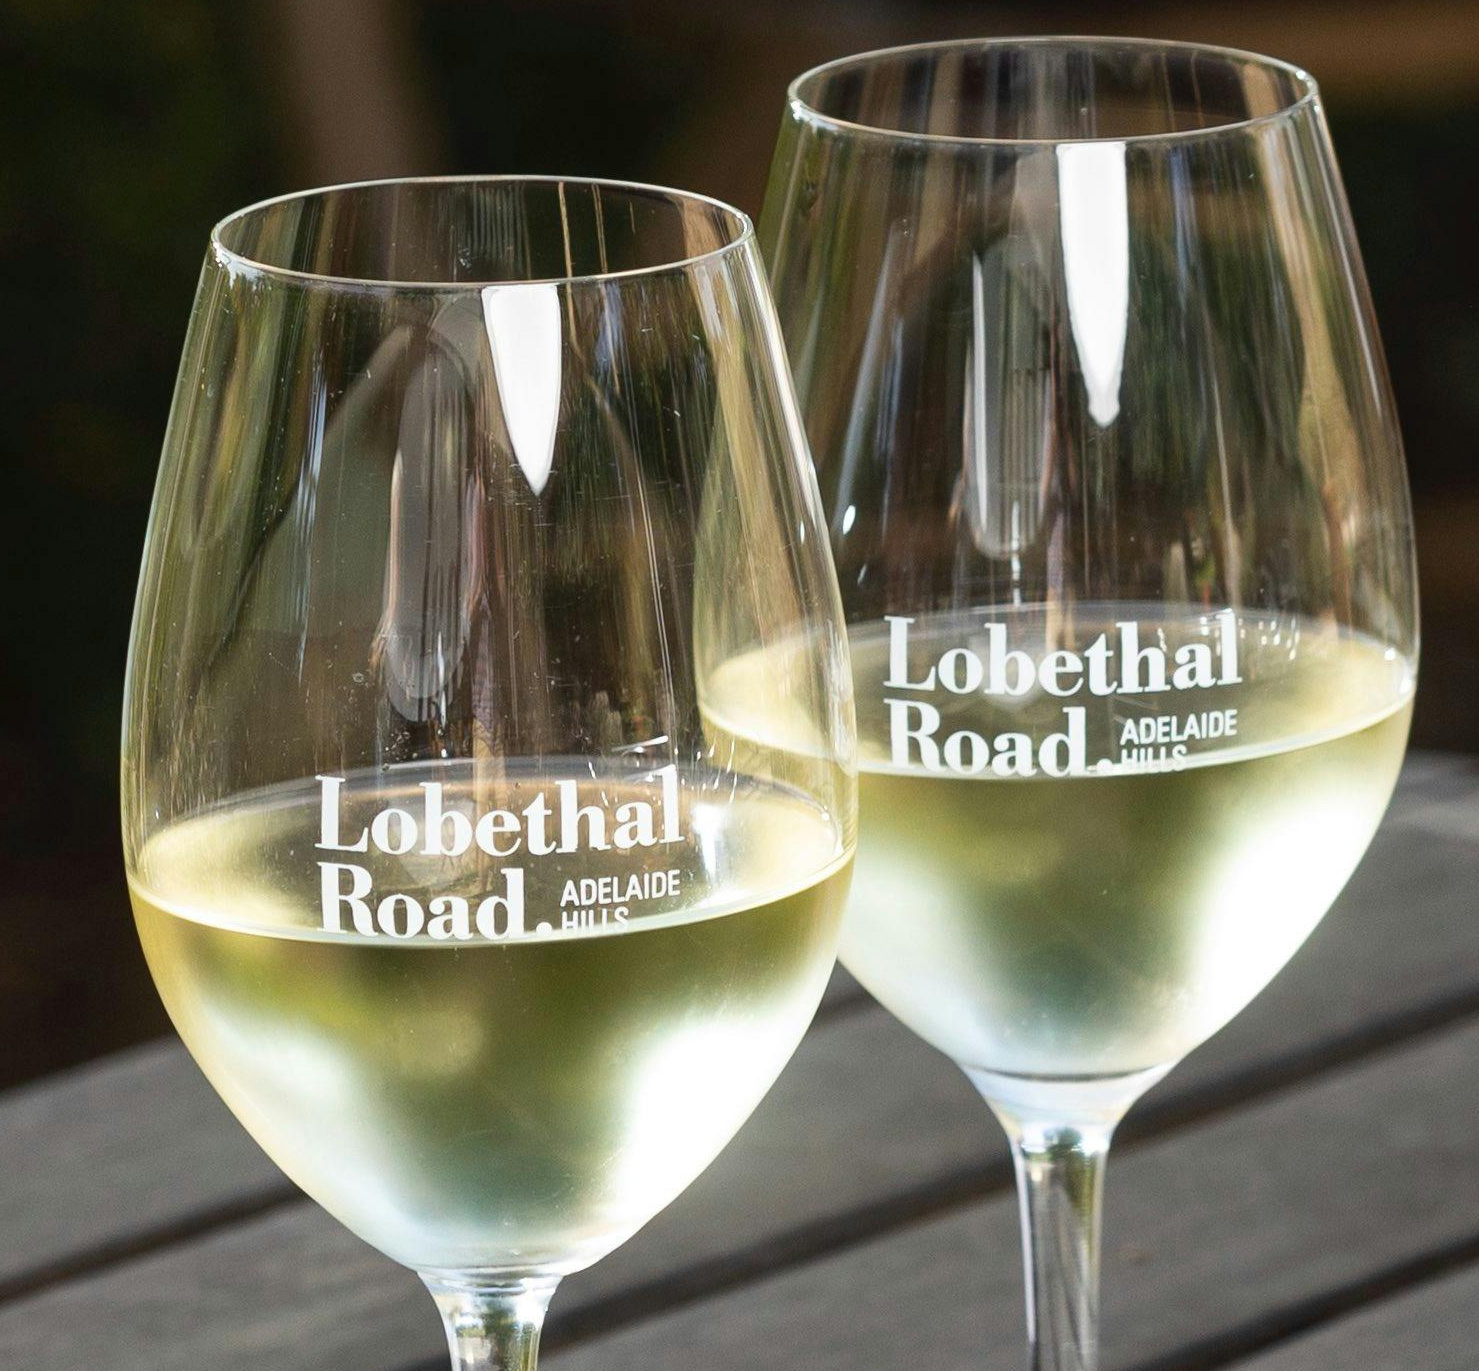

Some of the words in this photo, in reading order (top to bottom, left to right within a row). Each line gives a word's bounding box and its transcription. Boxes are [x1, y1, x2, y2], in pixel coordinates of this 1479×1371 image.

[883, 607, 1243, 697] Lobethal
[883, 697, 1113, 777] Road.
[1120, 709, 1238, 745] ADELAIDE
[1121, 744, 1187, 772] HILLS
[314, 763, 686, 857] Lobethal
[315, 860, 553, 941] Road.
[560, 869, 680, 907] ADELAIDE
